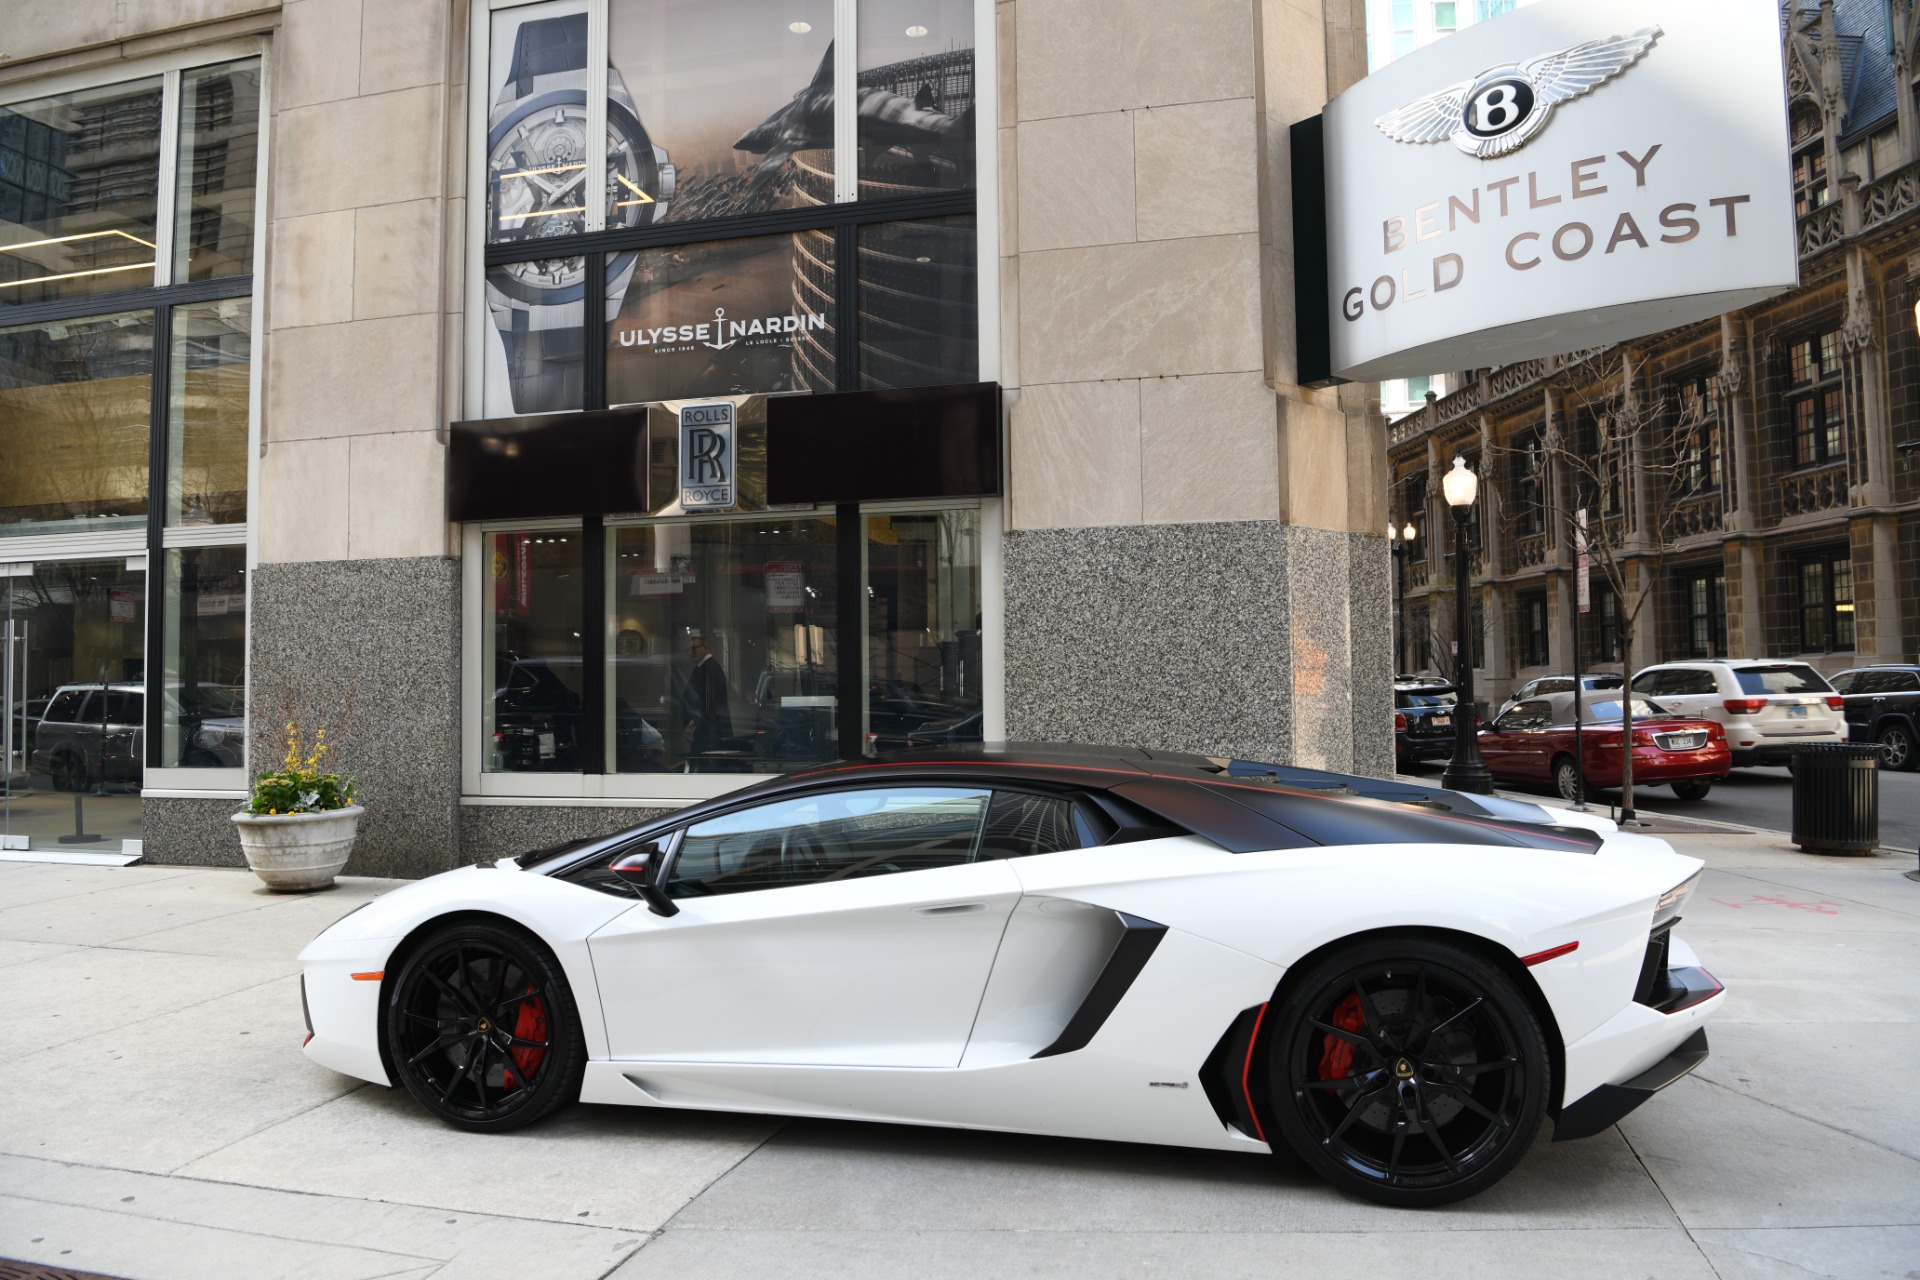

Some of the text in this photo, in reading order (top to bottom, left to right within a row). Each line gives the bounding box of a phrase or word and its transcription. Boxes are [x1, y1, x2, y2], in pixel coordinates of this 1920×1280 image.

[1383, 144, 1662, 255] BENTLEY
[1342, 194, 1751, 322] GOLD COAST
[620, 313, 825, 347] ULYSSE NARDIN
[685, 409, 728, 423] ROLLS
[685, 488, 728, 502] ROYCE
